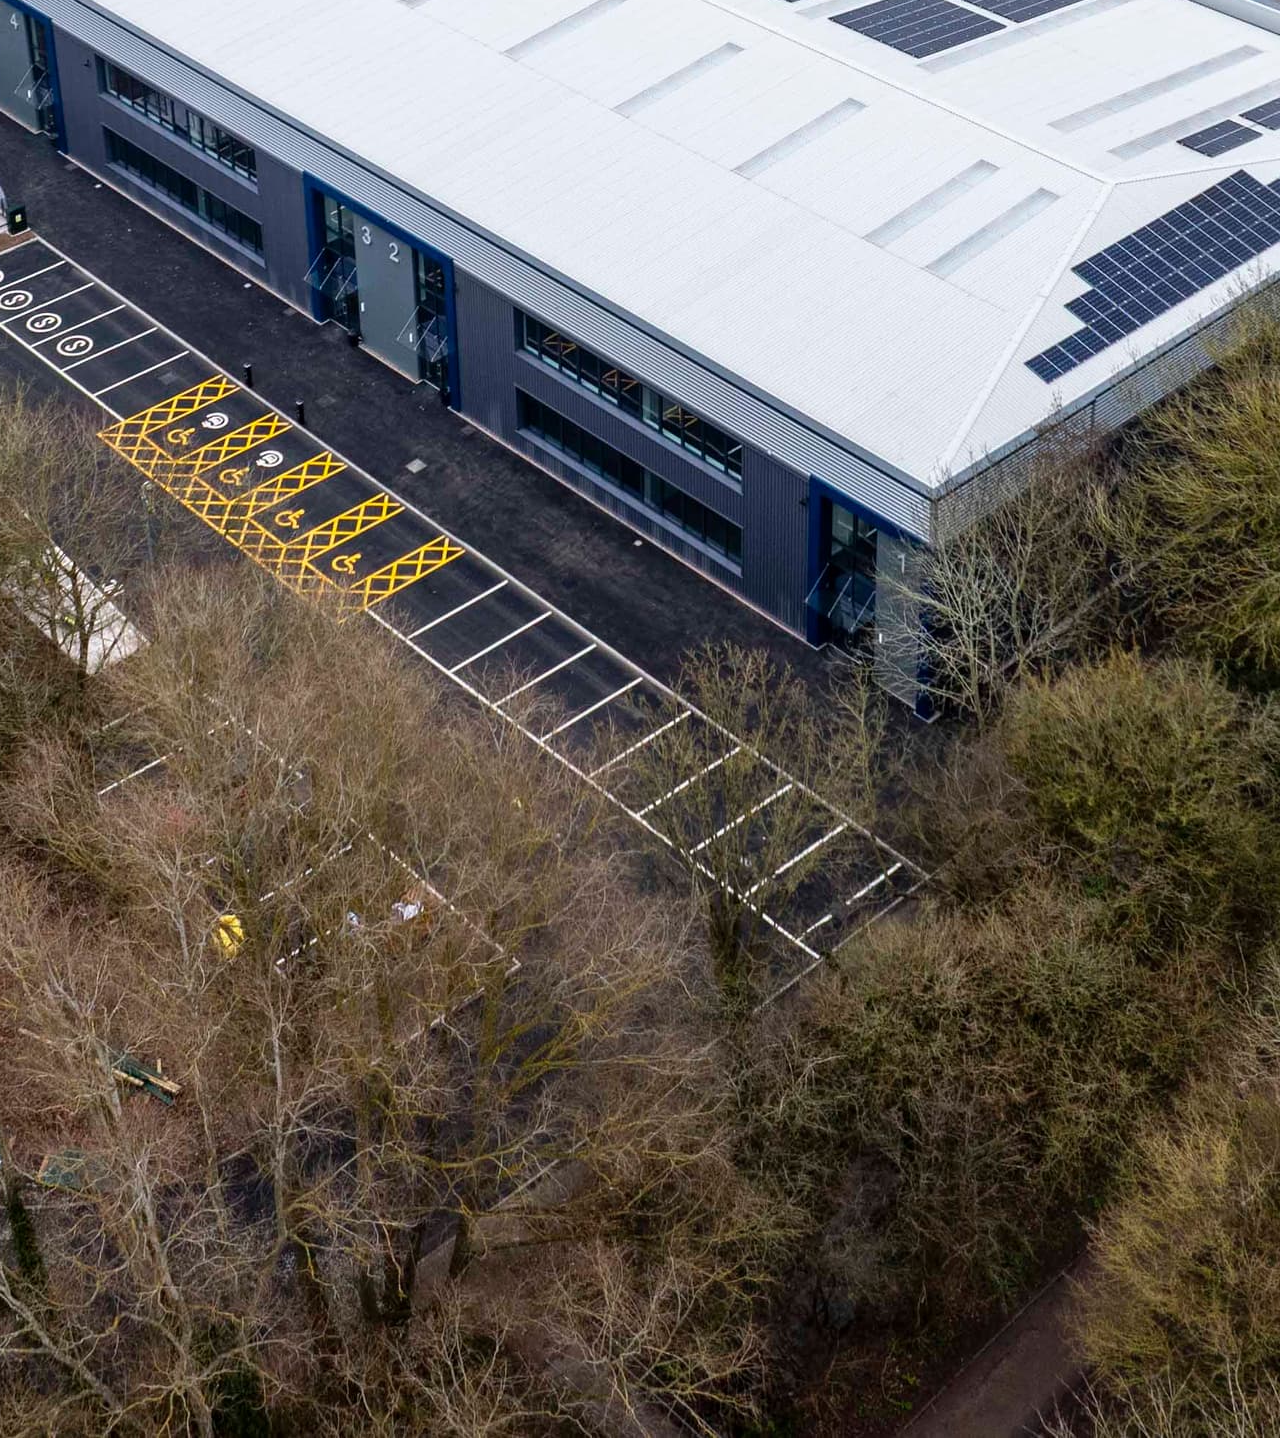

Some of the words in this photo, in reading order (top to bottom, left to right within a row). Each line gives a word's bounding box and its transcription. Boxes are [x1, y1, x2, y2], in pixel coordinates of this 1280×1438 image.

[10, 14, 19, 29] 4
[361, 225, 371, 245] 3
[389, 242, 399, 262] 2
